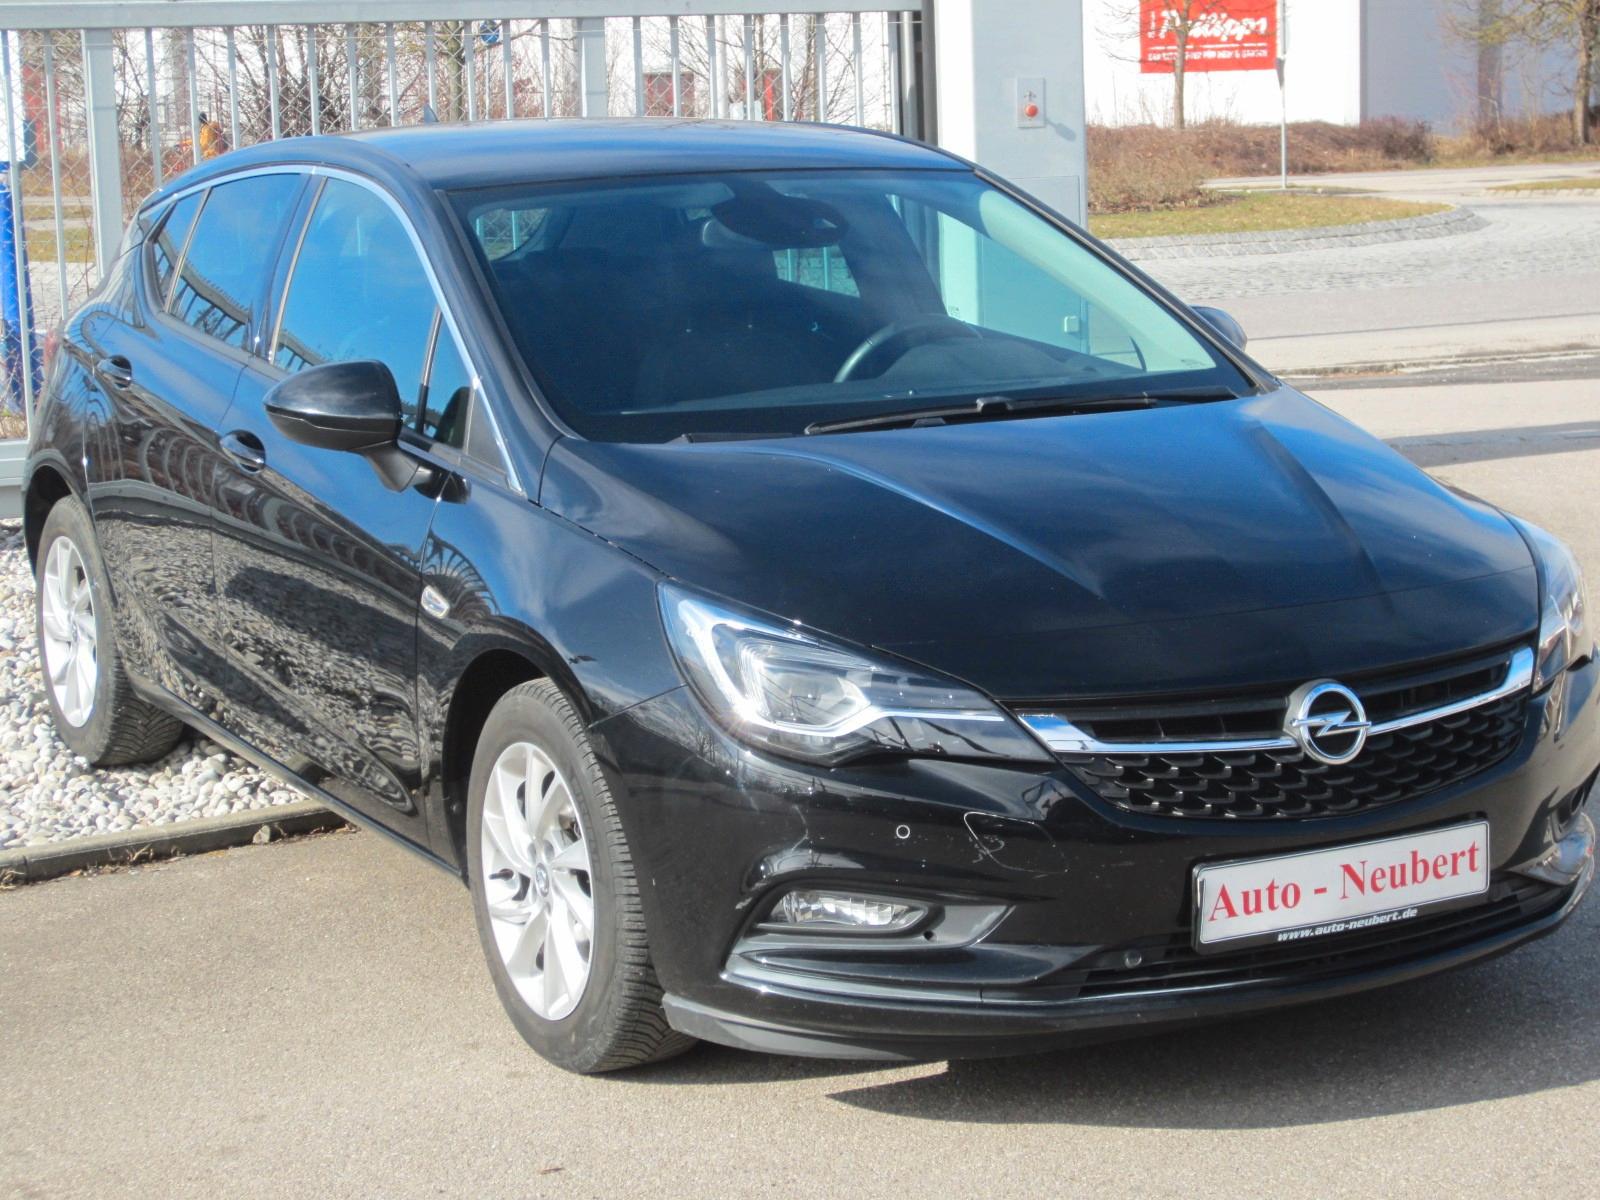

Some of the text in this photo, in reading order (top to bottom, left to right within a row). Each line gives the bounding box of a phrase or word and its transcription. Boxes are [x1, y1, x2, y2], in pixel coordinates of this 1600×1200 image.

[1208, 840, 1480, 922] Auto - Neubert
[1277, 907, 1418, 942] www.auto-neubert.de
